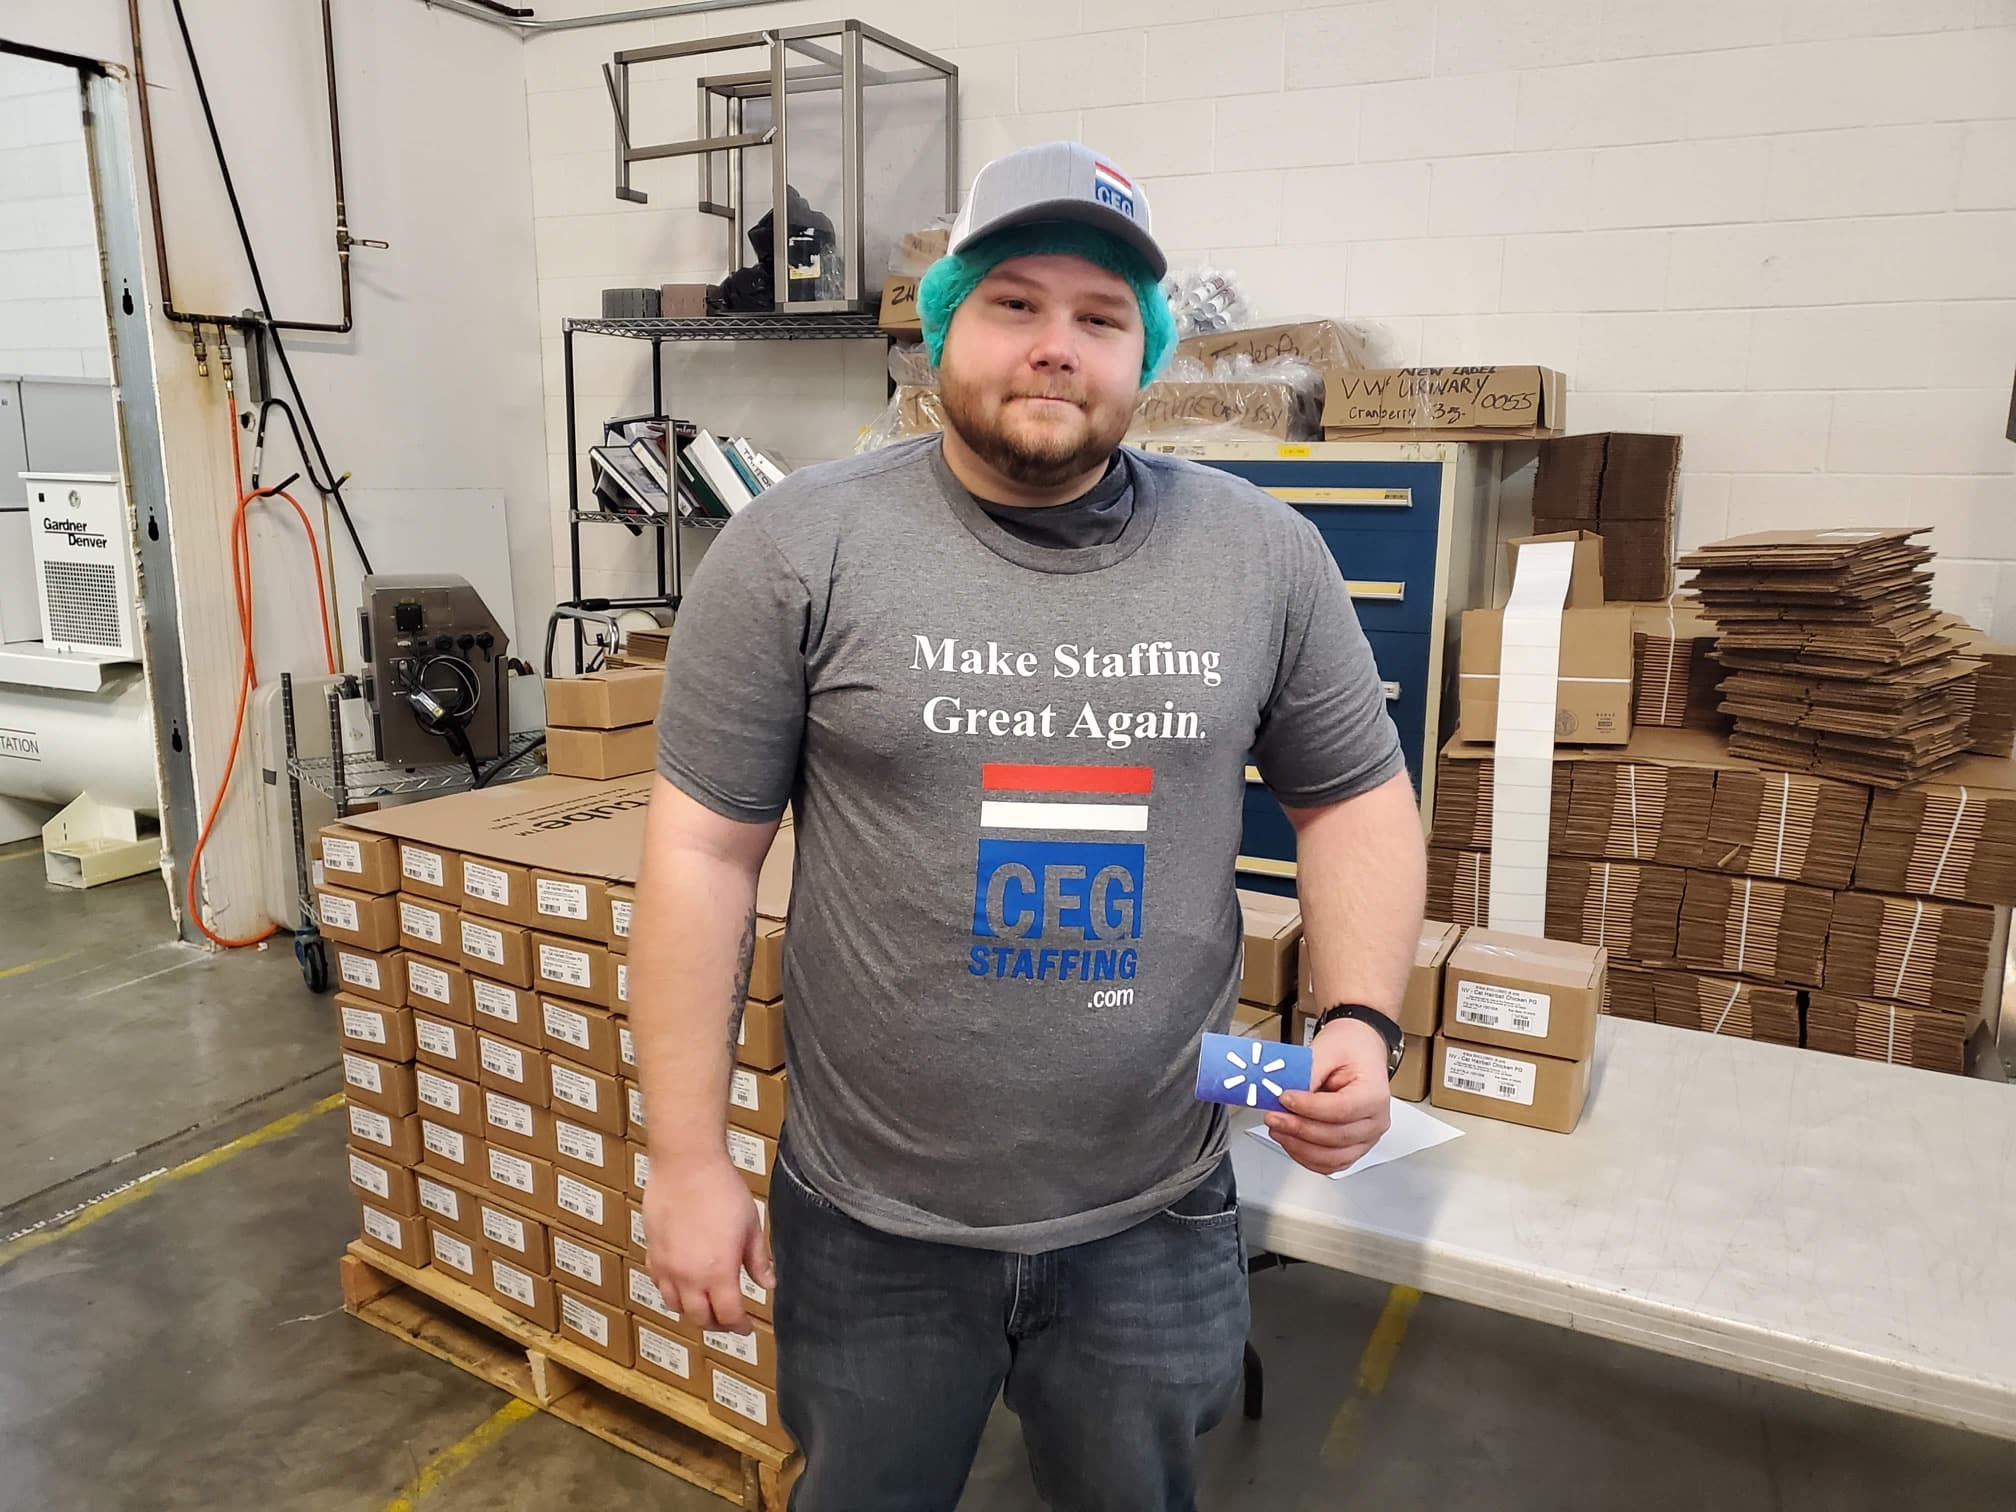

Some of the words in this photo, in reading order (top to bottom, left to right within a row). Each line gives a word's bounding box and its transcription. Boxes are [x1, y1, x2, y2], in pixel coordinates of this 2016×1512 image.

[1096, 185, 1132, 217] CEG
[1399, 374, 1490, 405] URINARY
[1349, 406, 1417, 424] Cranberry
[43, 517, 88, 532] Gardner
[67, 533, 108, 548] Denver
[908, 634, 1038, 677] Make
[1053, 641, 1222, 687] Staffing
[922, 695, 1056, 738] Great
[1067, 700, 1207, 749] Again.
[984, 862, 1135, 940] CEG
[967, 945, 1138, 982] STAFFING
[1086, 987, 1135, 1009] .com
